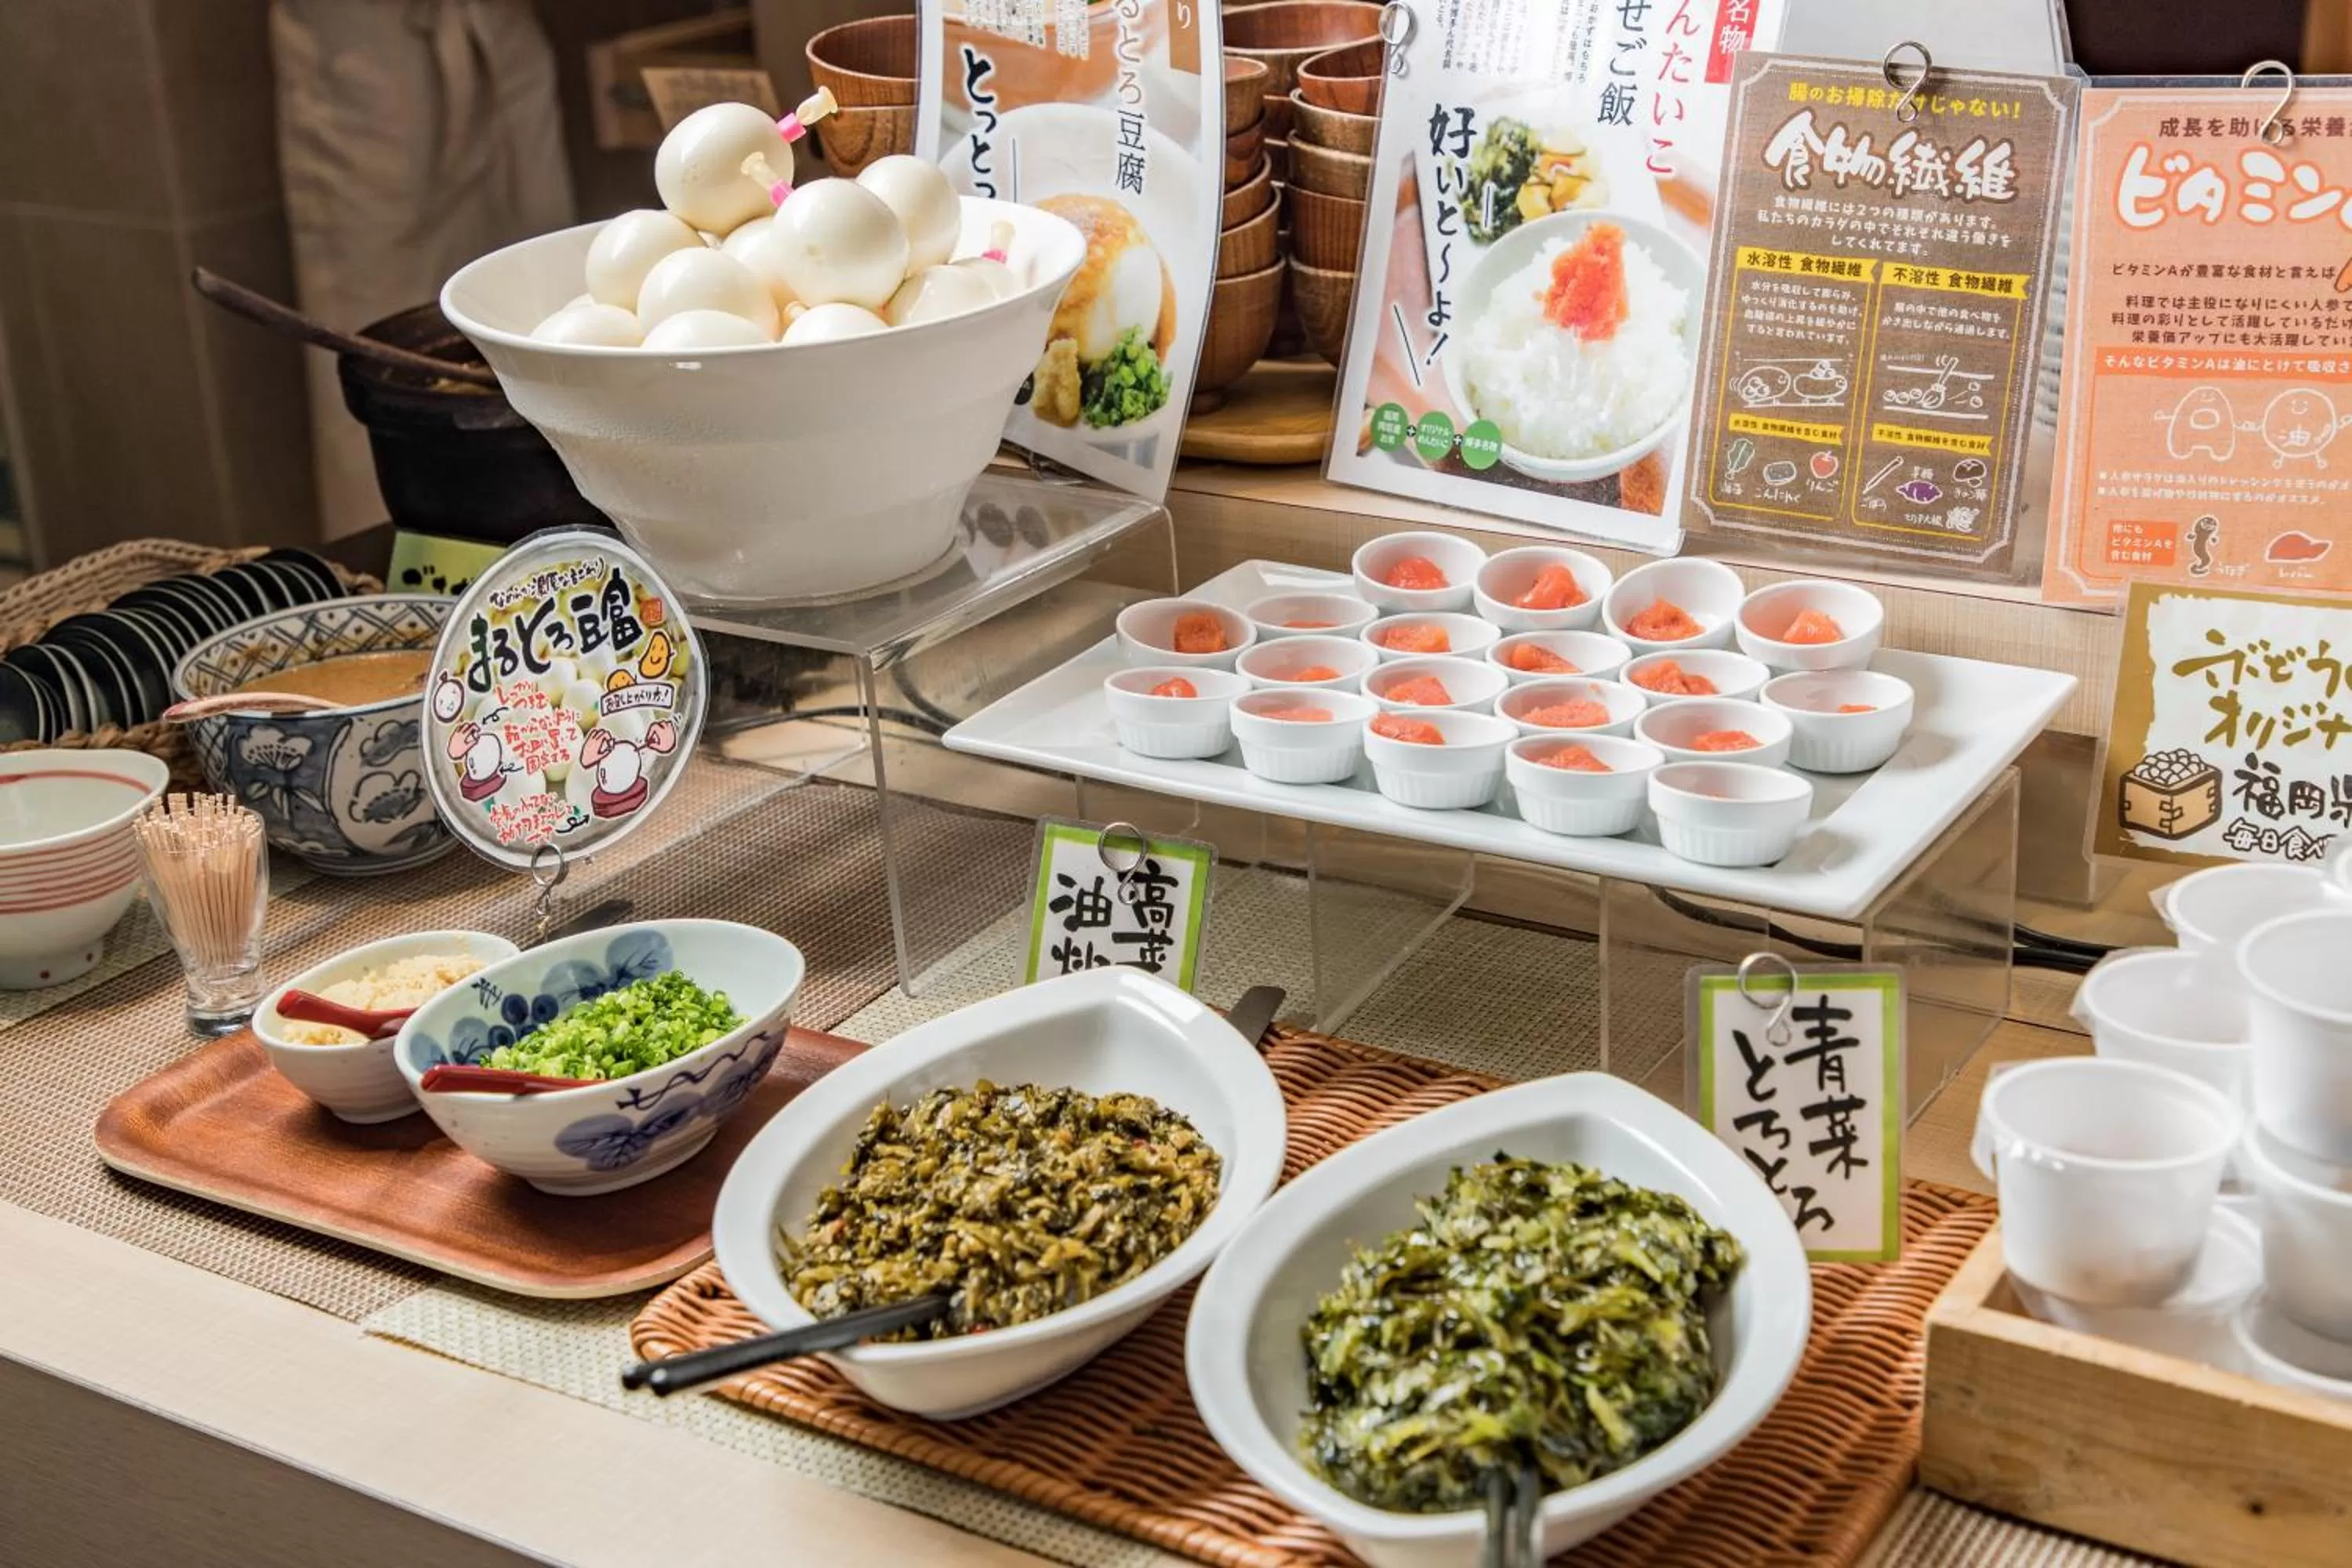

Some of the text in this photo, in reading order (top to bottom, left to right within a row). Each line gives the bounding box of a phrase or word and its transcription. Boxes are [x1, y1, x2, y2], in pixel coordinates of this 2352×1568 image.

[1719, 0, 1750, 55] 名物
[1646, 0, 1700, 172] んたいこ
[1764, 107, 2016, 201] 食物繊維
[2159, 117, 2352, 138] 成長を助る栄養
[2118, 145, 2352, 227] ビタミン
[1747, 252, 1862, 277] 水溶性 食物繊維
[1893, 267, 2013, 292] 不溶性 食物繊維
[2132, 330, 2352, 347] 栄養価アップにも大活躍してい
[1784, 994, 1869, 1179] 青菜
[1732, 1029, 1835, 1232] とろとろ
